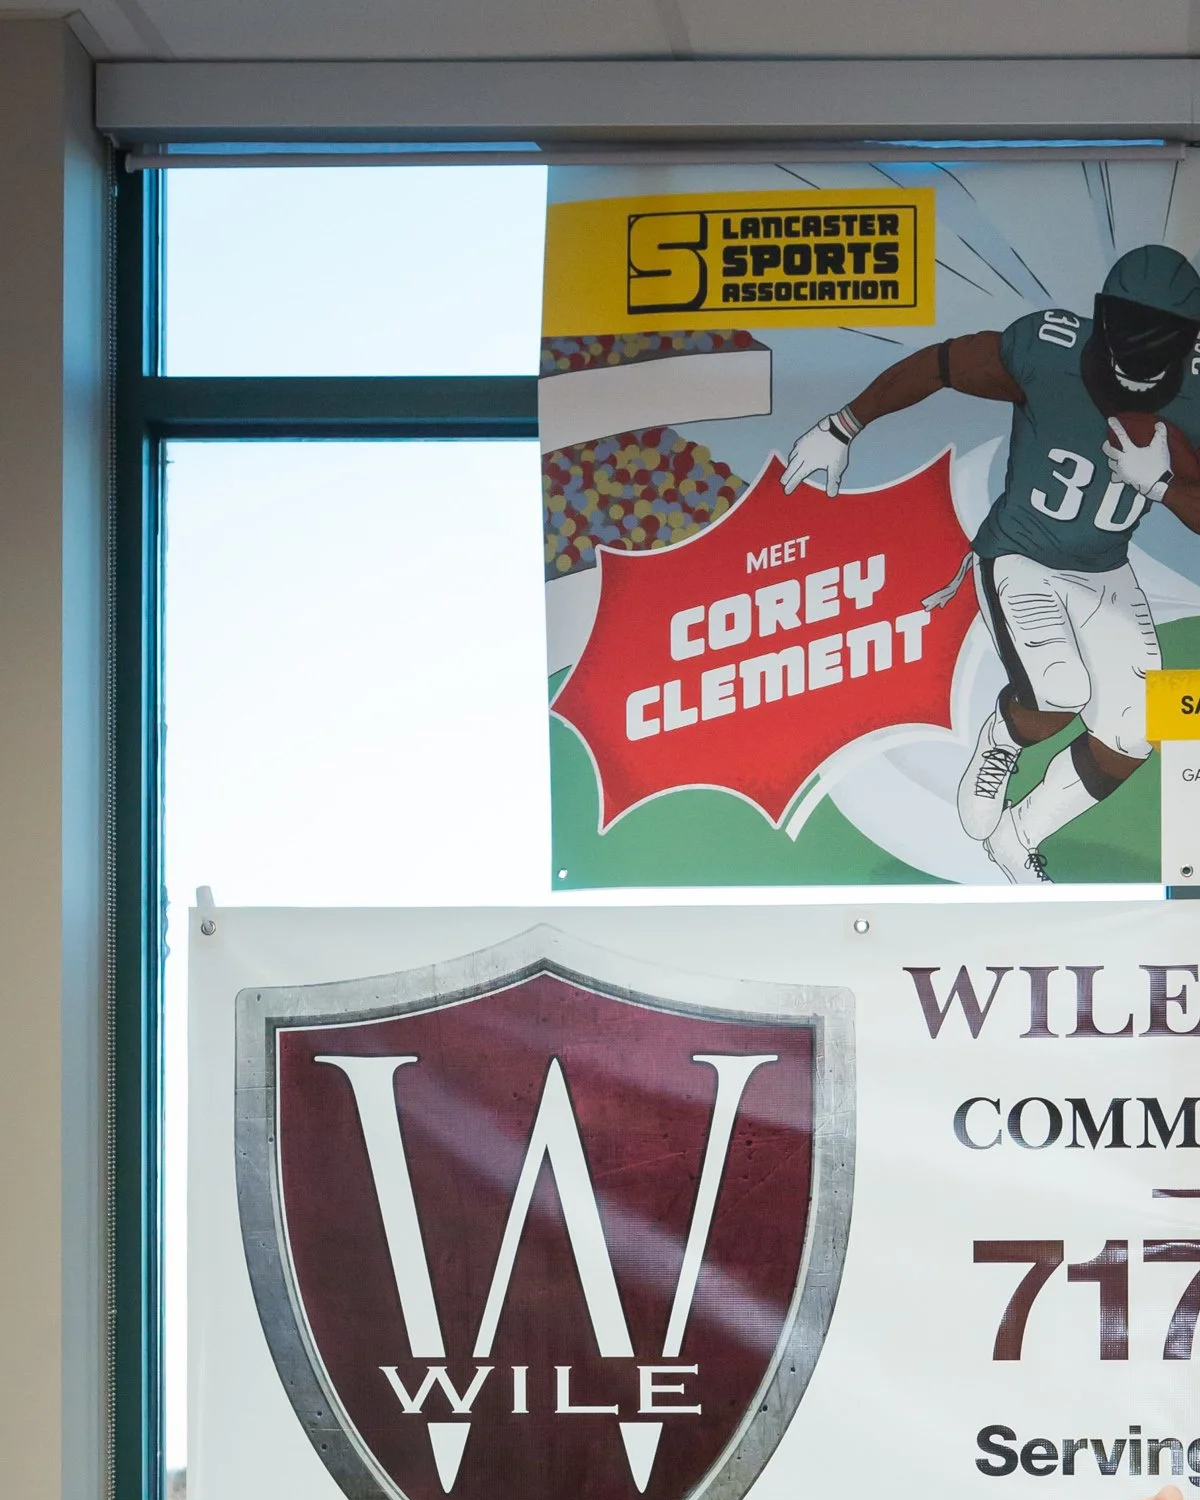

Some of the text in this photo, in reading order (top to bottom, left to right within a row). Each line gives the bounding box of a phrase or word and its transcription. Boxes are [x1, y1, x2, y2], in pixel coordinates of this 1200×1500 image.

[722, 213, 899, 240] LANCASTER
[722, 242, 899, 278] SPORTS
[722, 280, 899, 303] ASSOCIATION
[1030, 448, 1147, 532] 30
[746, 535, 810, 574] MEET
[670, 553, 886, 662] COREY
[625, 609, 932, 742] CLEMENT
[379, 1365, 702, 1415] WILE
